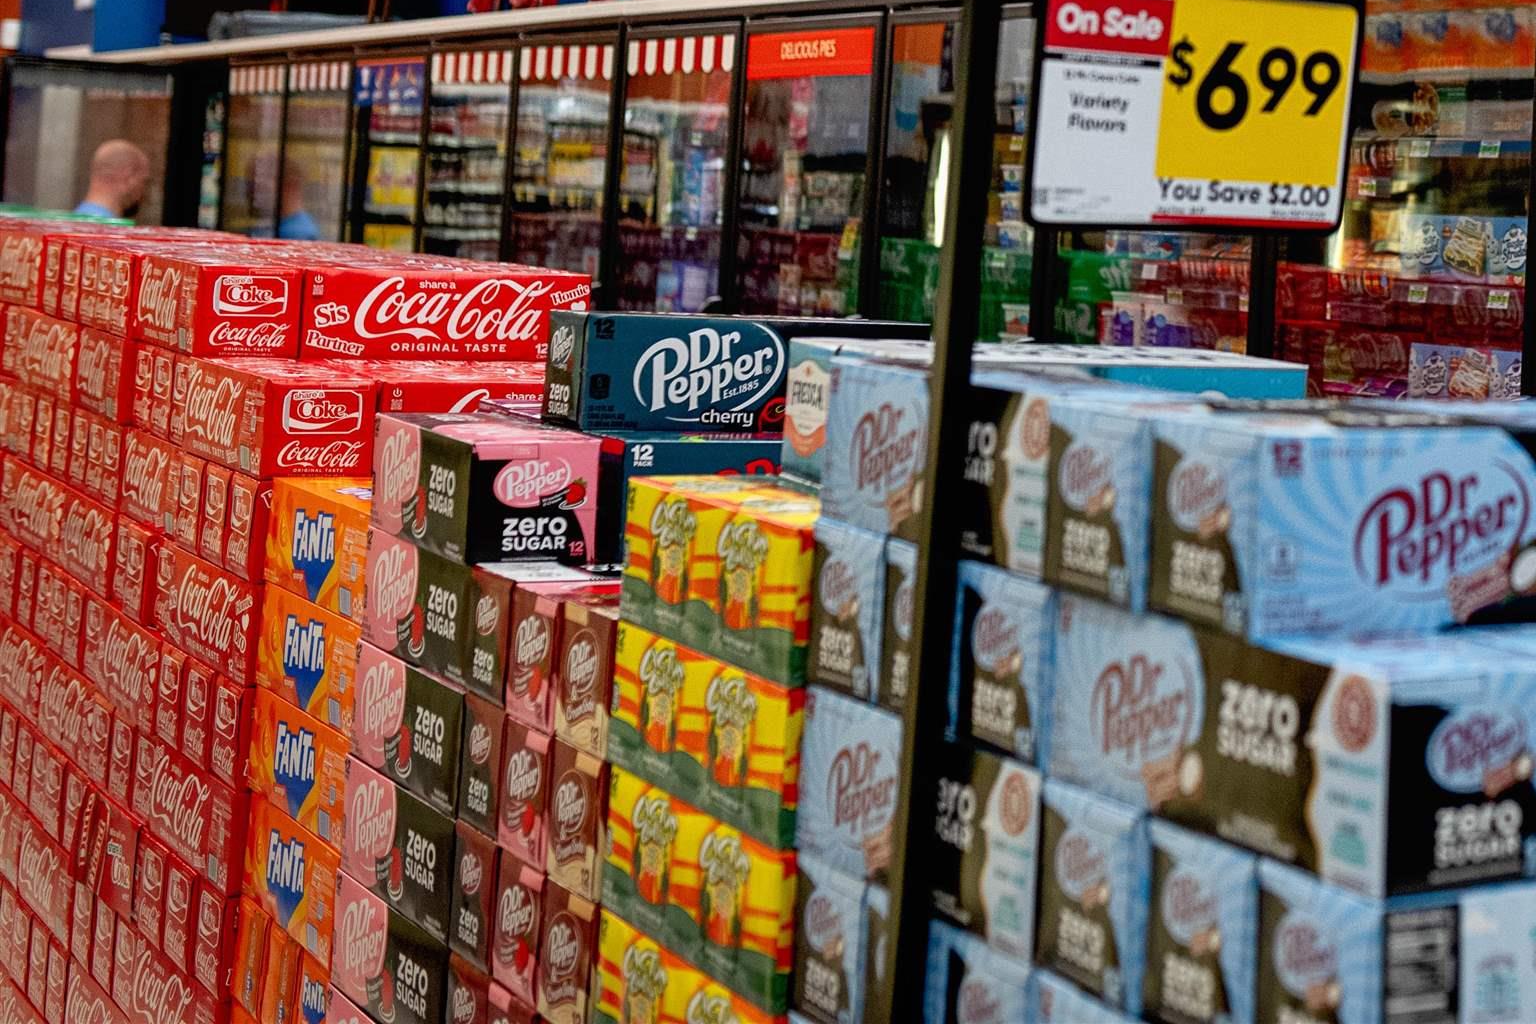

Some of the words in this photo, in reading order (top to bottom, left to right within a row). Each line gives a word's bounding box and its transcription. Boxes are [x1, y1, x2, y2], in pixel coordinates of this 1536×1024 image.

[1056, 2, 1100, 34] On
[1103, 7, 1164, 41] Sale
[780, 40, 819, 60] DELICIOUS
[820, 39, 837, 59] PIES
[1157, 180, 1201, 202] You
[1207, 181, 1261, 204] Save
[1267, 182, 1330, 207] $2.00
[227, 286, 273, 303] Coke
[419, 281, 448, 289] share
[551, 283, 591, 306] Homie
[314, 302, 350, 327] Sis
[354, 276, 555, 342] Coca-Cola
[208, 321, 291, 347] Coca-Cola
[305, 329, 365, 356] Partner
[390, 342, 461, 353] ORIGINAL
[464, 343, 507, 353] TASTE
[688, 327, 739, 364] Dr
[638, 335, 776, 413] Pepper
[505, 392, 536, 401] share
[549, 383, 571, 403] zero
[185, 368, 243, 447] Coca-Cola
[297, 401, 346, 419] Coke
[547, 401, 569, 416] SUGAR
[701, 408, 754, 428] cherry
[277, 440, 366, 468] Coca-Cola
[631, 444, 654, 462] 12
[428, 464, 457, 491] zero
[523, 456, 550, 481] Dr
[503, 464, 566, 502] Pepper
[427, 489, 455, 518] SUGAR
[1421, 471, 1478, 532] Dr
[292, 508, 336, 564] FANTA
[502, 516, 567, 537] zero
[1372, 490, 1518, 586] Pepper
[501, 533, 565, 552] SUGAR
[568, 540, 586, 554] 12
[428, 586, 457, 619] zero
[426, 612, 456, 641] SUGAR
[283, 614, 325, 672] FANTA
[473, 647, 495, 667] zero
[472, 663, 493, 683] SUGAR
[415, 704, 445, 735] zero
[274, 720, 316, 782] FANTA
[413, 733, 443, 765] SUGAR
[469, 776, 489, 798] zero
[467, 795, 488, 816] SUGAR
[407, 829, 437, 859] zero
[267, 828, 307, 894] FANTA
[405, 862, 436, 892] SUGAR
[397, 953, 429, 987] zero
[395, 983, 427, 1020] SUGAR
